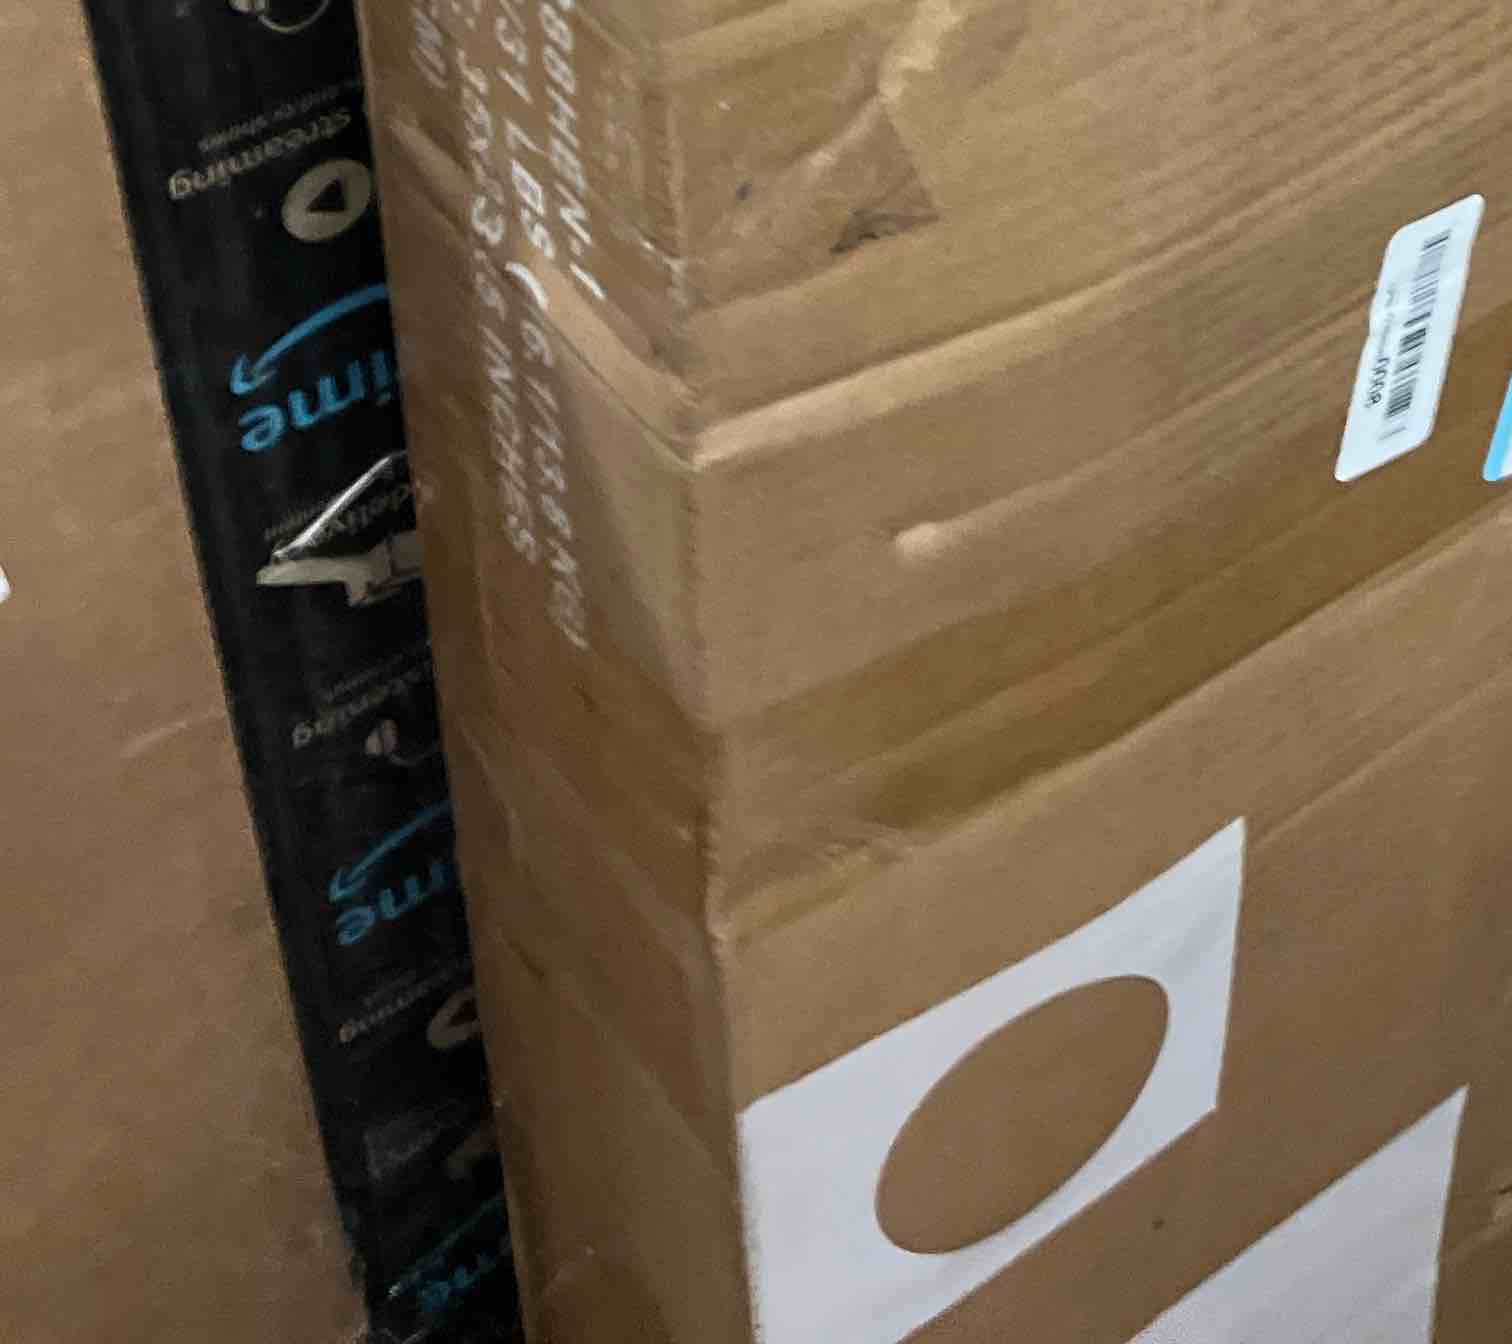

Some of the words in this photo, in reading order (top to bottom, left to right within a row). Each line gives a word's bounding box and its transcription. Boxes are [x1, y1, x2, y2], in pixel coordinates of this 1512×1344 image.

[505, 118, 556, 261] LBS
[237, 350, 396, 454] ime
[480, 324, 537, 565] INCHES
